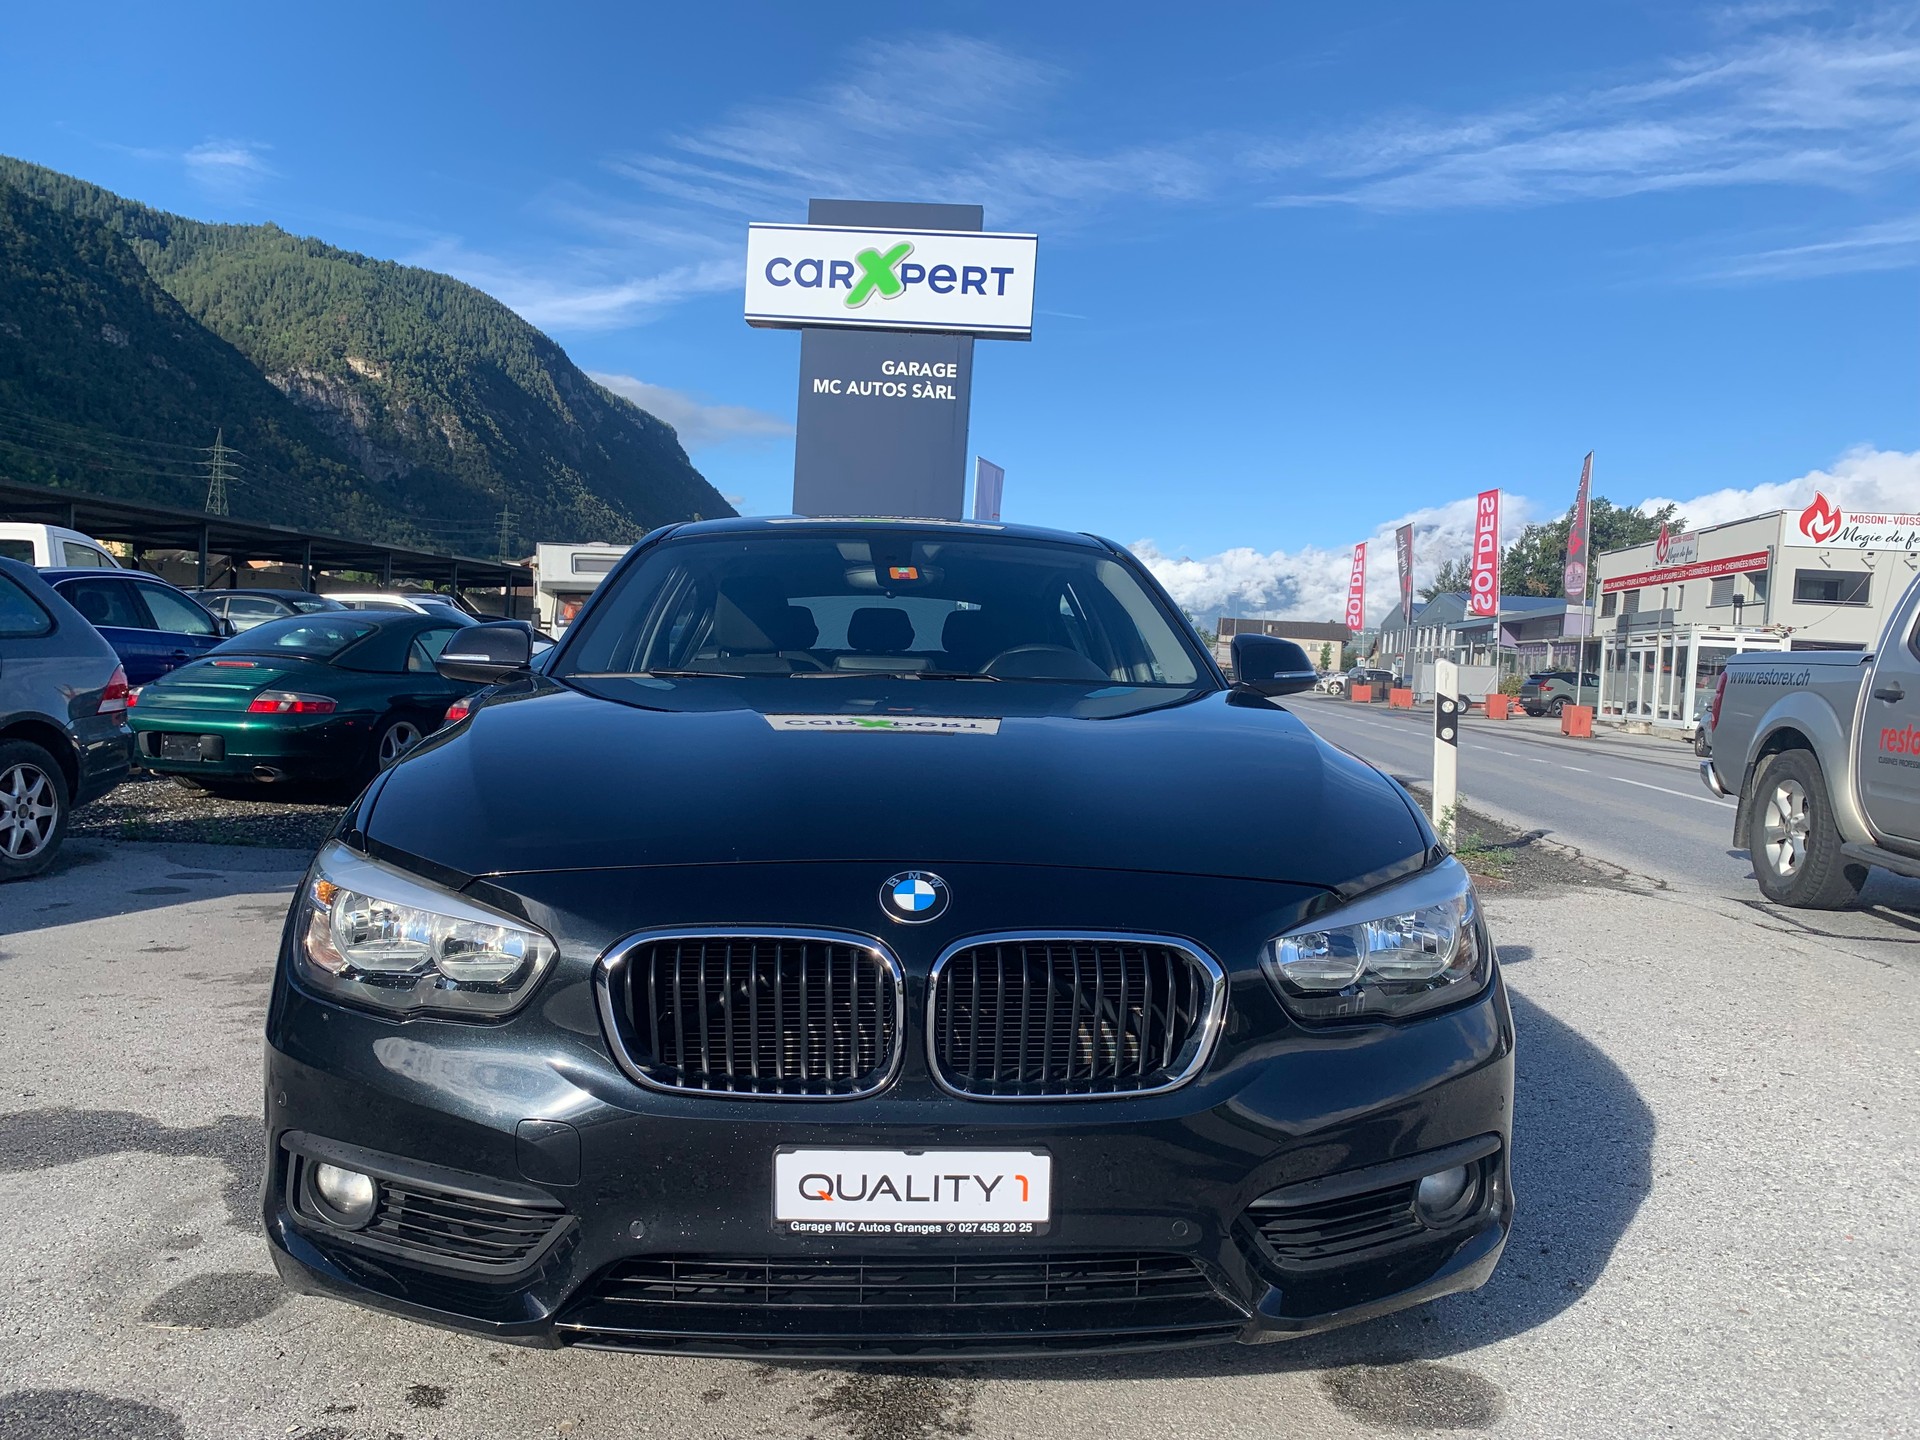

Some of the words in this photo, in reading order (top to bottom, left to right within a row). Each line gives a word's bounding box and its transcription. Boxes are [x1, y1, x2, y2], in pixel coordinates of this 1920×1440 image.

[881, 360, 957, 378] GARAGE
[813, 379, 842, 394] MC
[846, 381, 907, 397] AUTOS
[1830, 525, 1884, 548] Magie
[1885, 529, 1905, 543] du
[1730, 668, 1811, 686] www.restorex.ch
[887, 872, 942, 888] BMW
[798, 1174, 1004, 1202] QUALITY
[1015, 1174, 1029, 1202] 1
[790, 1221, 832, 1234] Garage
[834, 1221, 855, 1232] MC
[857, 1222, 891, 1232] Autos
[894, 1222, 942, 1235] Granges
[958, 1222, 979, 1233] 027
[979, 1222, 1000, 1233] 458
[1002, 1222, 1016, 1233] 20
[1018, 1222, 1033, 1233] 25
